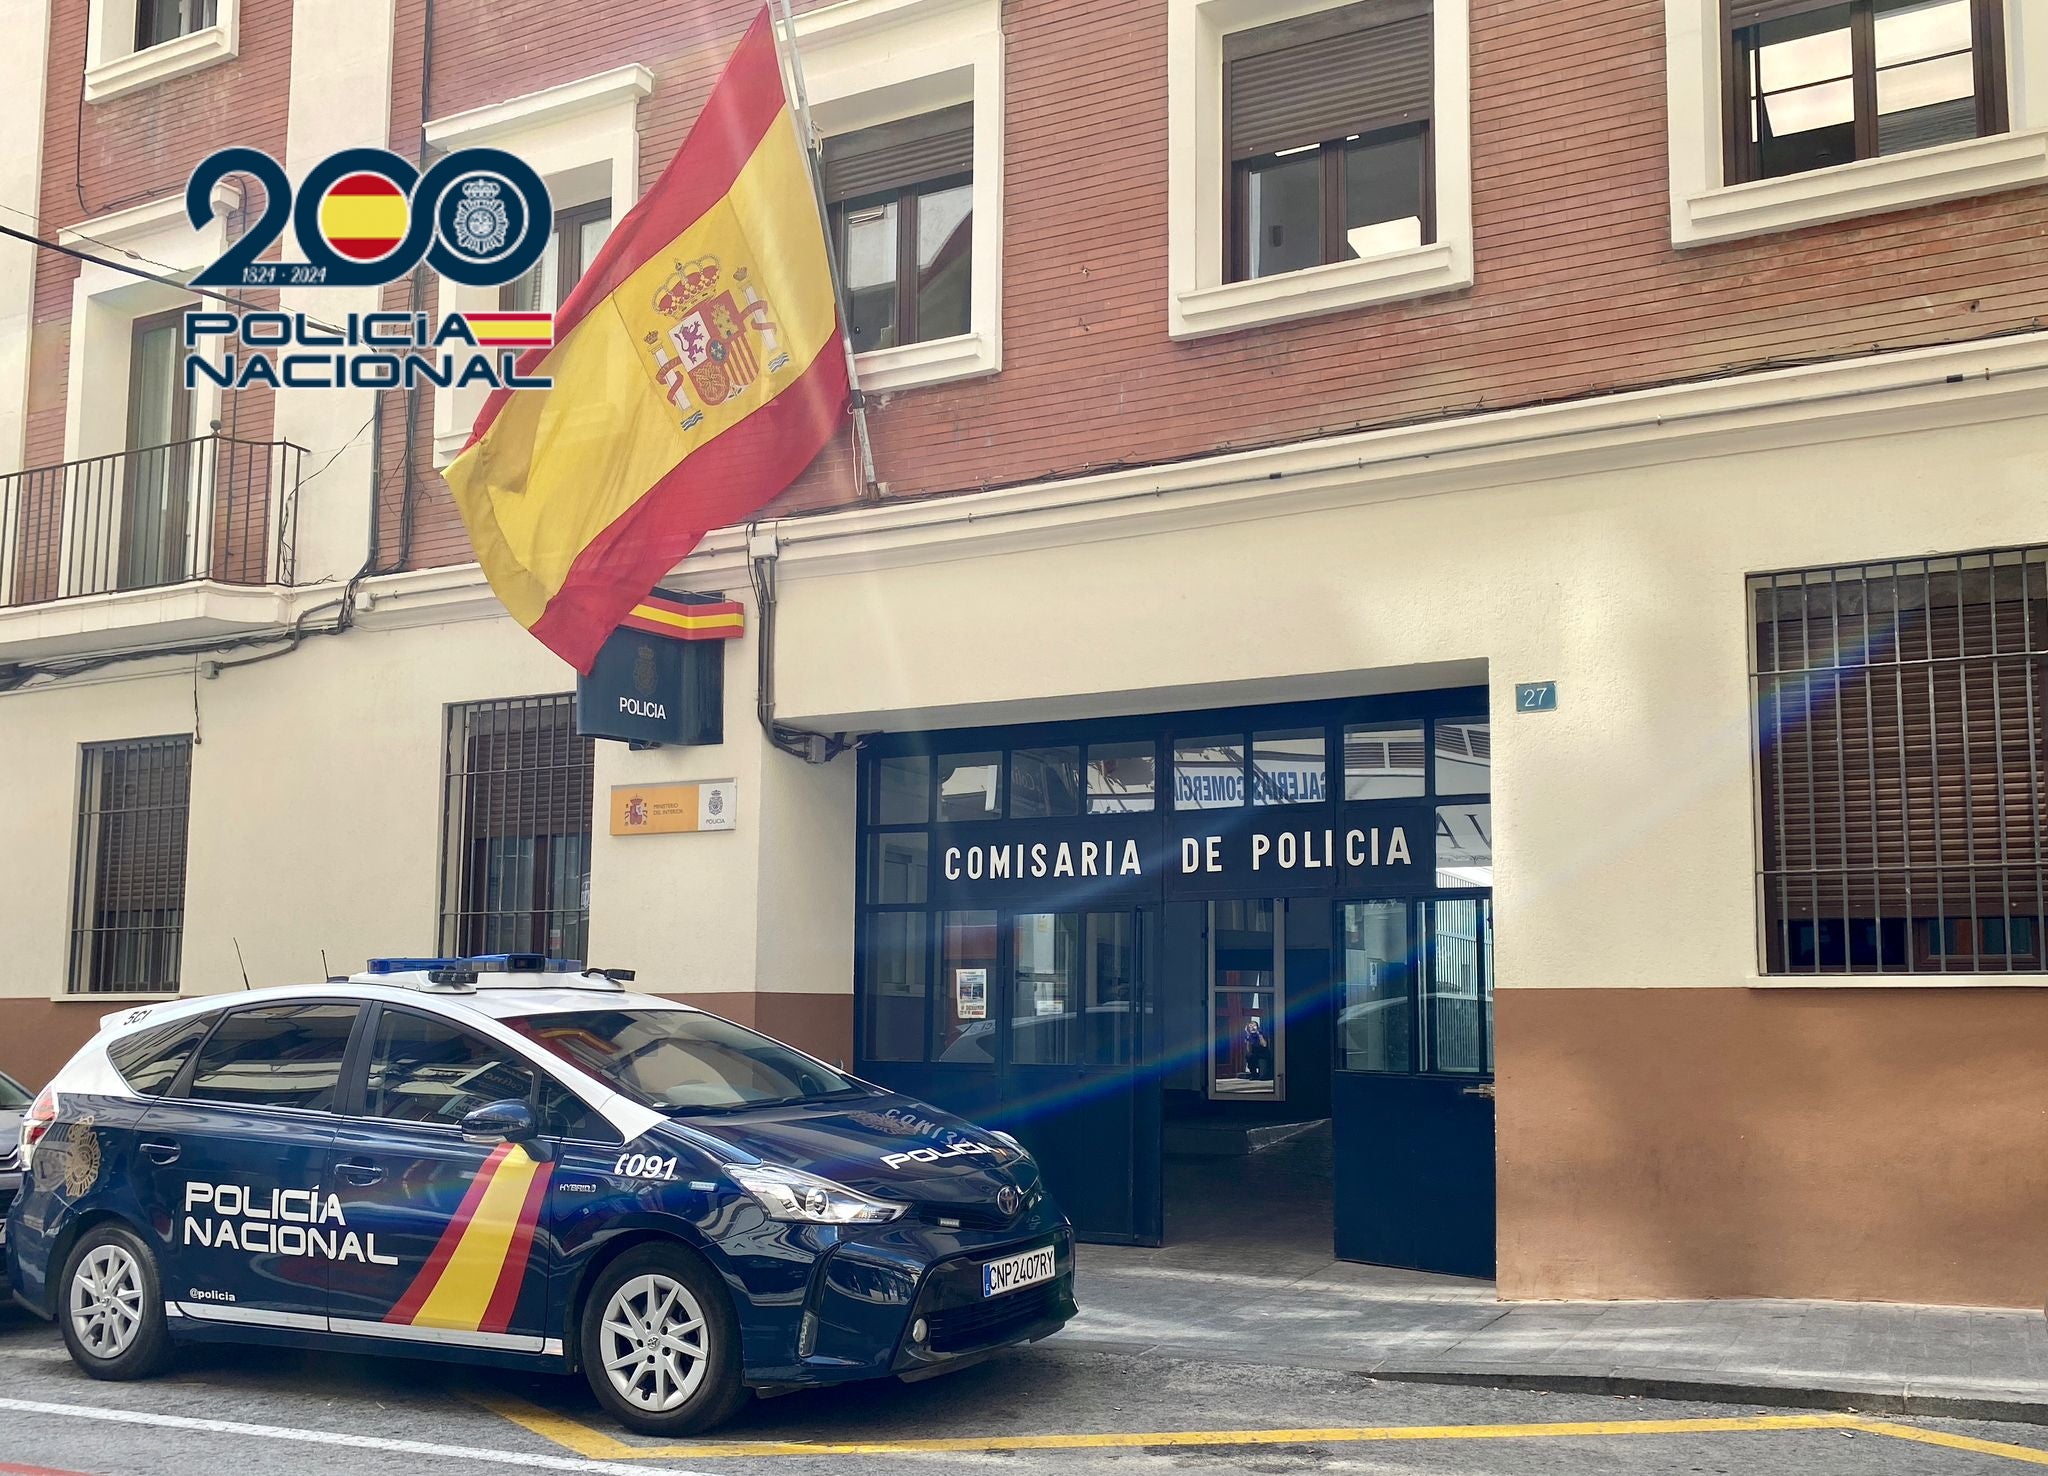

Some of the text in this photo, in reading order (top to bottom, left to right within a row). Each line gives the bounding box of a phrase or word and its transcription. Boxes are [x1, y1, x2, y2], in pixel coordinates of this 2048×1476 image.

[619, 696, 667, 720] POLICIA
[1524, 688, 1547, 707] 27
[944, 826, 1412, 881] COMISARIA DE POLICIA
[184, 1181, 347, 1226] POLICÍA
[183, 1216, 399, 1266] NACIONAL
[990, 1250, 1053, 1291] CNP2407RY
[190, 1287, 236, 1302] @policia
